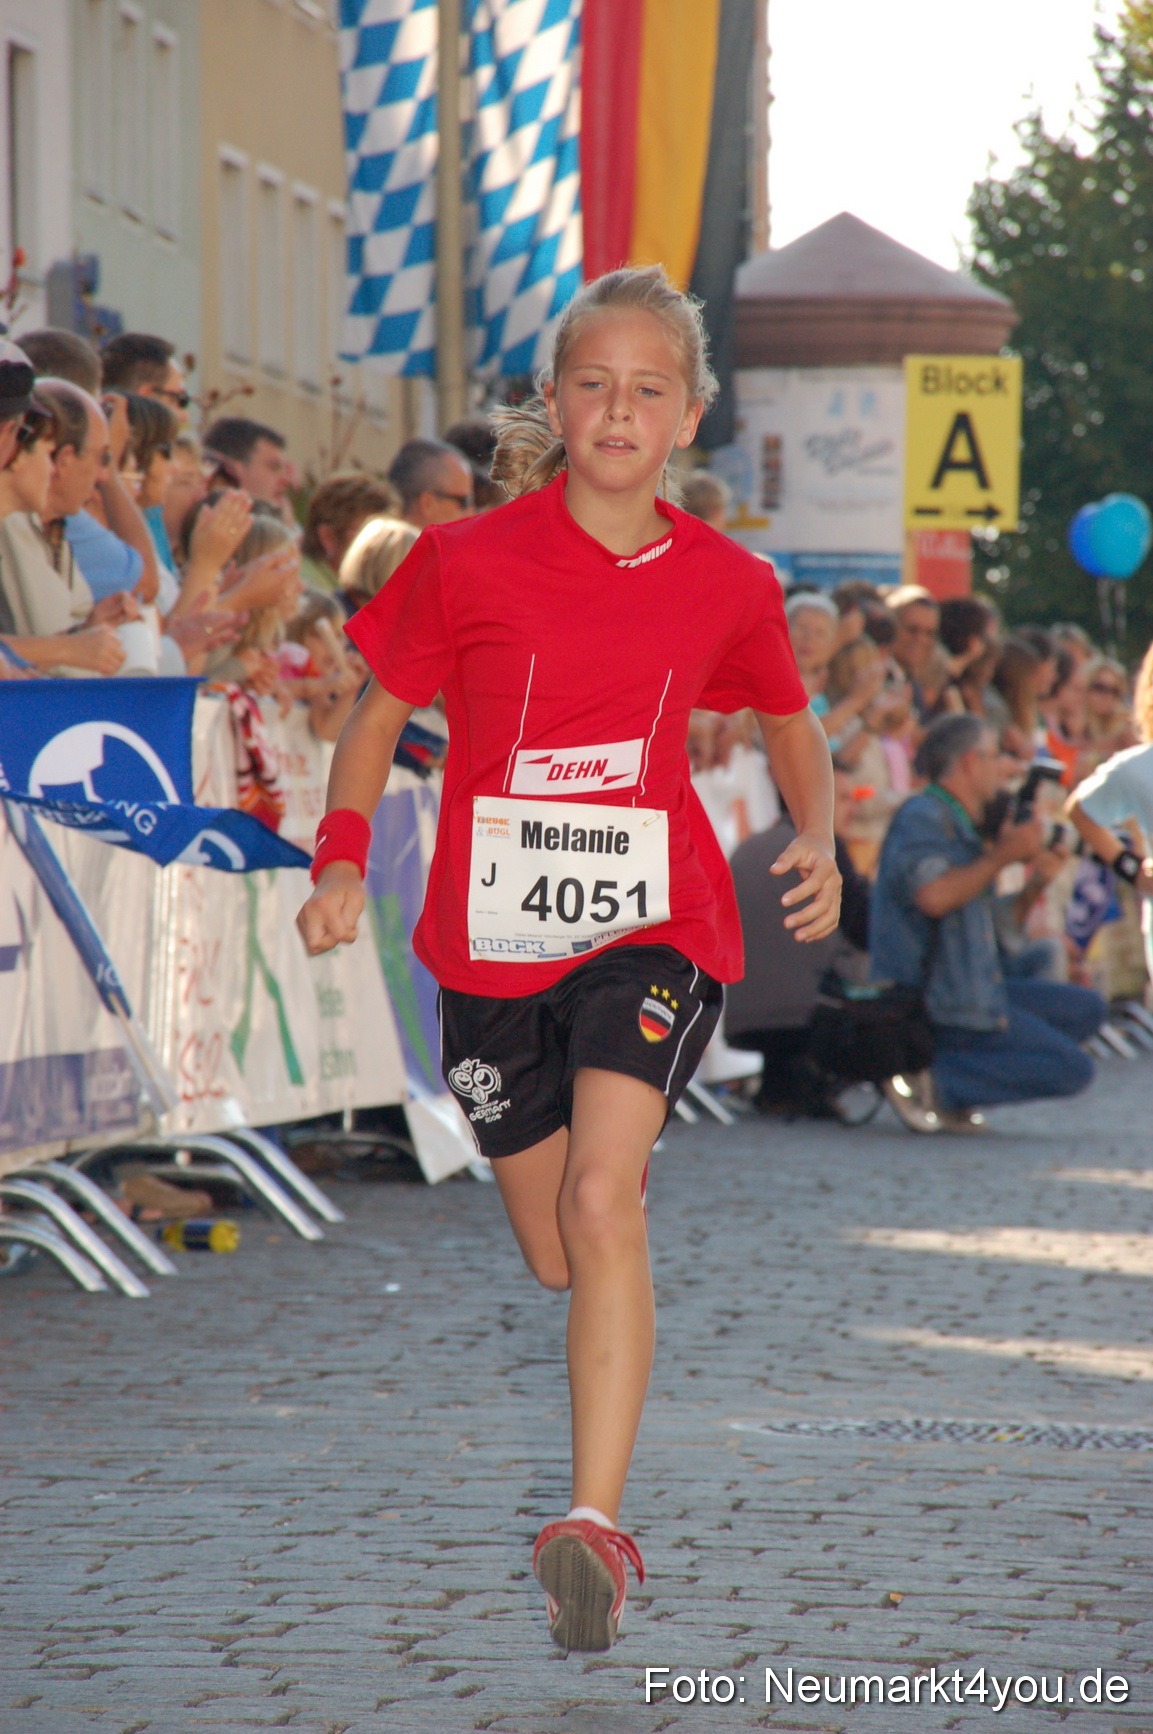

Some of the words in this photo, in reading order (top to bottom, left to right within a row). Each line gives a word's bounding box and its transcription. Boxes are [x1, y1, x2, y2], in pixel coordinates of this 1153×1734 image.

[920, 365, 1009, 395] Block
[929, 409, 991, 490] A
[546, 758, 609, 781] DEHN
[521, 820, 630, 855] Melanie
[481, 862, 497, 887] J
[521, 875, 648, 924] 4051
[473, 937, 546, 954] BOCK
